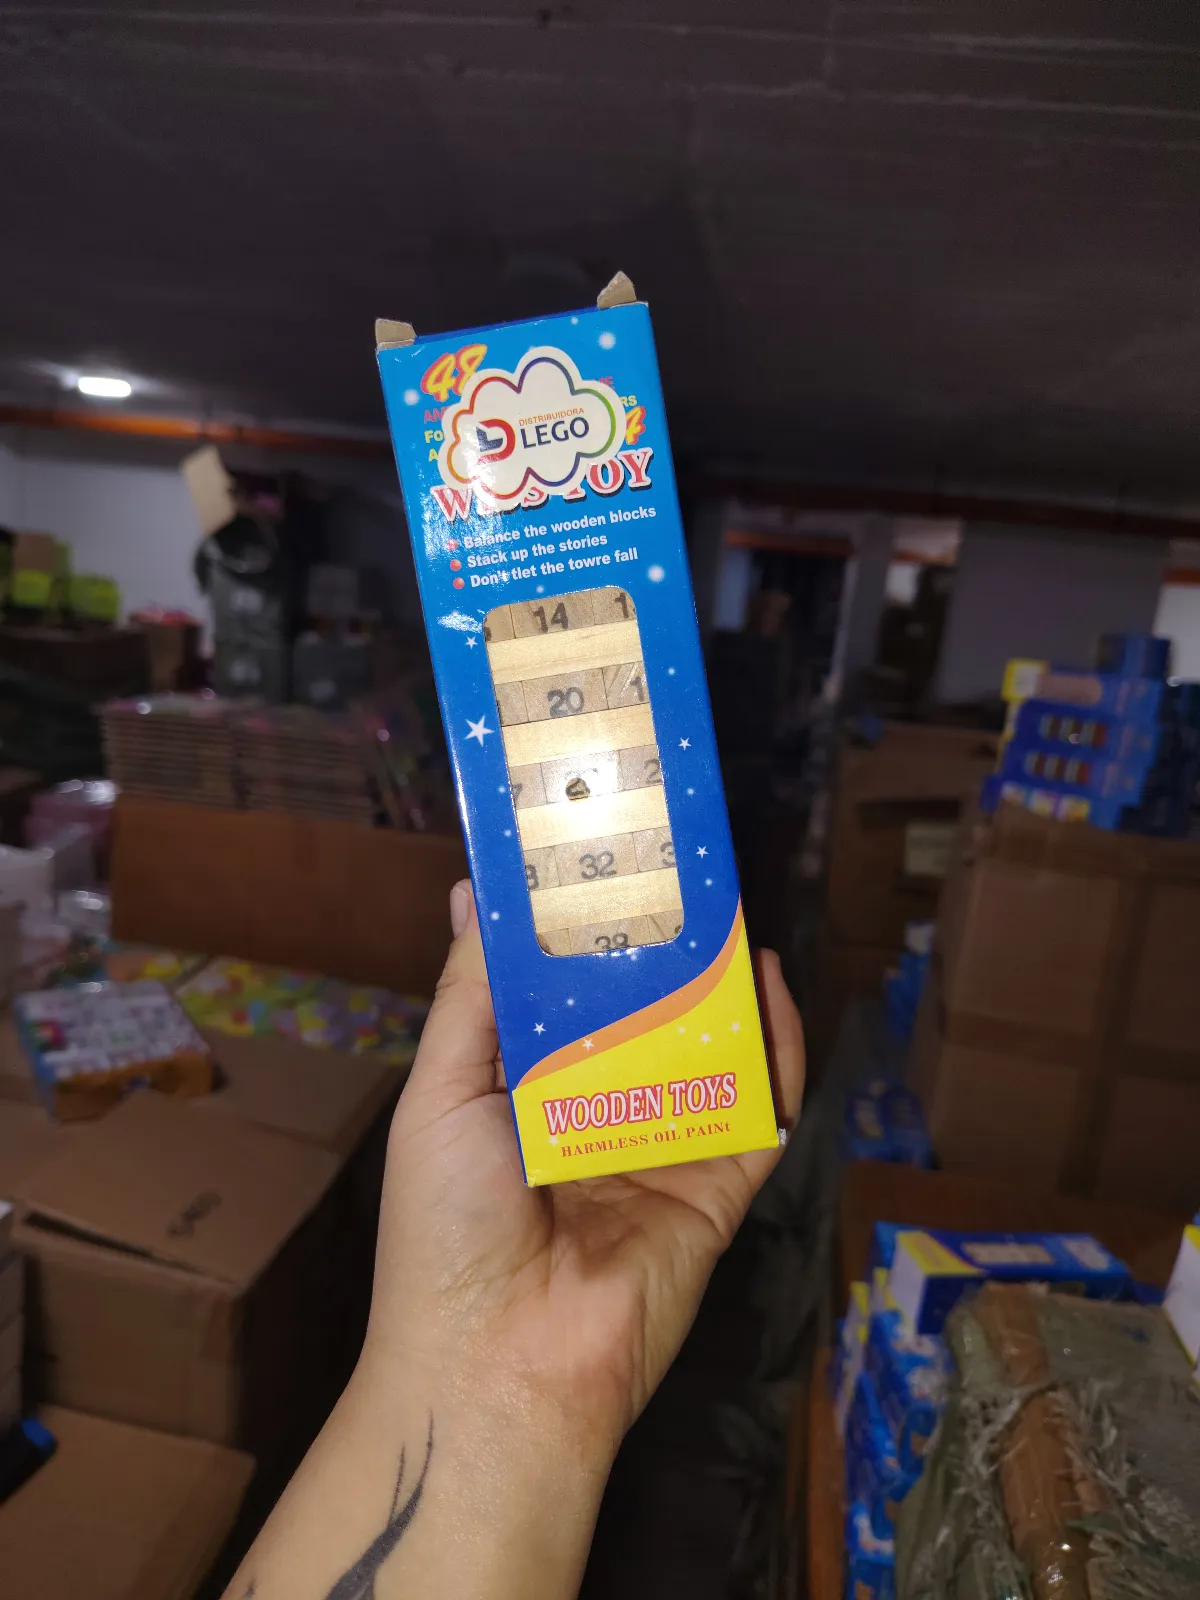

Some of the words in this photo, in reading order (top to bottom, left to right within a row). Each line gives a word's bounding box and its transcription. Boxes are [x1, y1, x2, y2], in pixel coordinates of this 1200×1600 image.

[421, 344, 488, 402] 48
[519, 407, 585, 427] DISTRIBUIDORA
[520, 416, 590, 449] LEGO
[424, 430, 446, 444] FO
[463, 530, 521, 550] Balance
[524, 524, 548, 538] the
[550, 515, 607, 533] wooden
[609, 505, 657, 524] blocks
[467, 550, 508, 569] Stack
[511, 548, 529, 562] up
[532, 543, 556, 557] the
[558, 534, 608, 552] stories
[540, 561, 565, 576] the
[568, 554, 611, 571] towre
[614, 547, 639, 563] fall
[533, 602, 569, 634] 14
[546, 687, 585, 718] 20
[578, 851, 617, 880] 32
[542, 1085, 664, 1136] WOODEN
[668, 1071, 738, 1116] TOYS
[561, 1132, 650, 1158] HARMLESS
[653, 1128, 682, 1144] OIL
